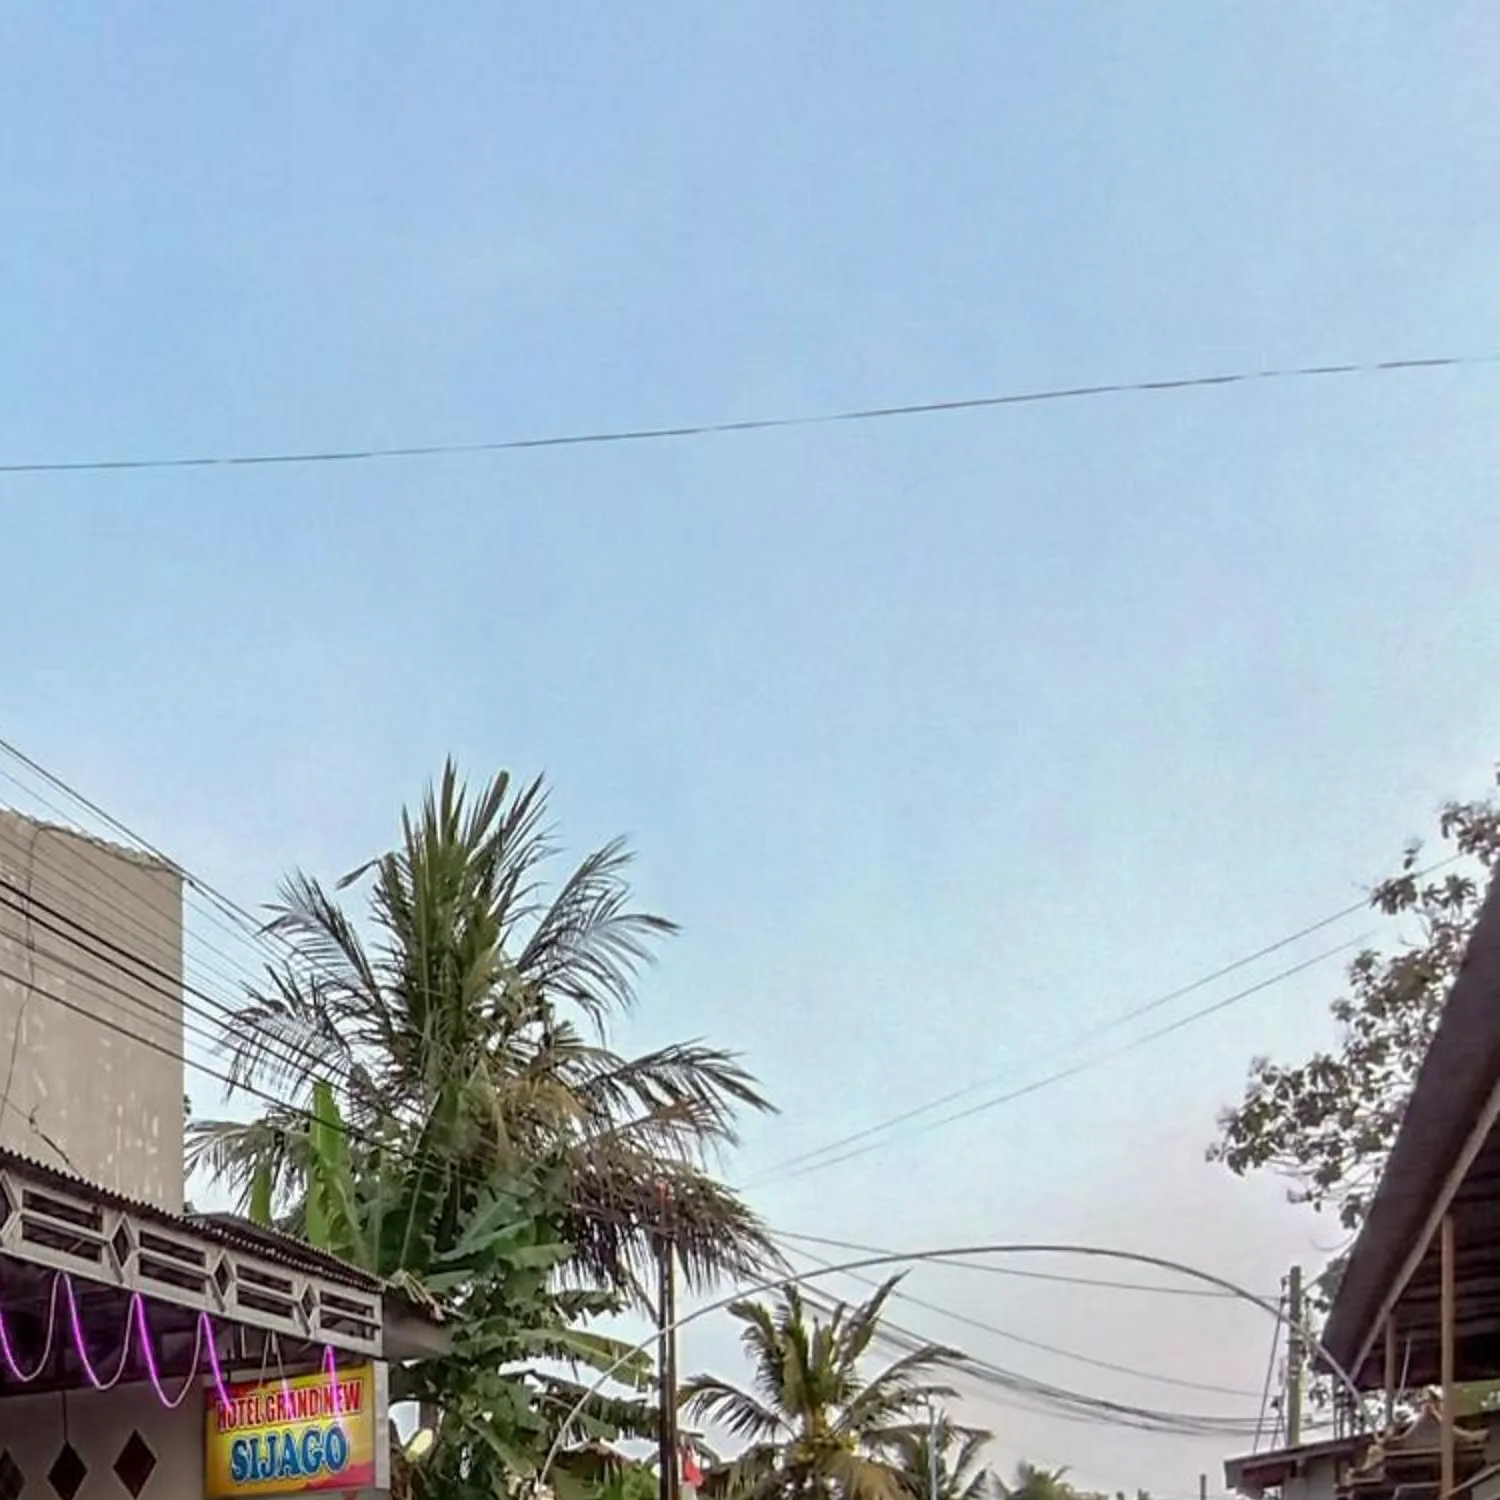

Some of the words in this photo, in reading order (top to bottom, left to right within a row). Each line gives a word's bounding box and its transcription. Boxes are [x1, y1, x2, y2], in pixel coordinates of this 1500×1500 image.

[218, 1397, 263, 1430] HOTEL
[267, 1387, 323, 1423] GRAND
[324, 1381, 361, 1414] NEW
[231, 1423, 348, 1483] SIJAGO
